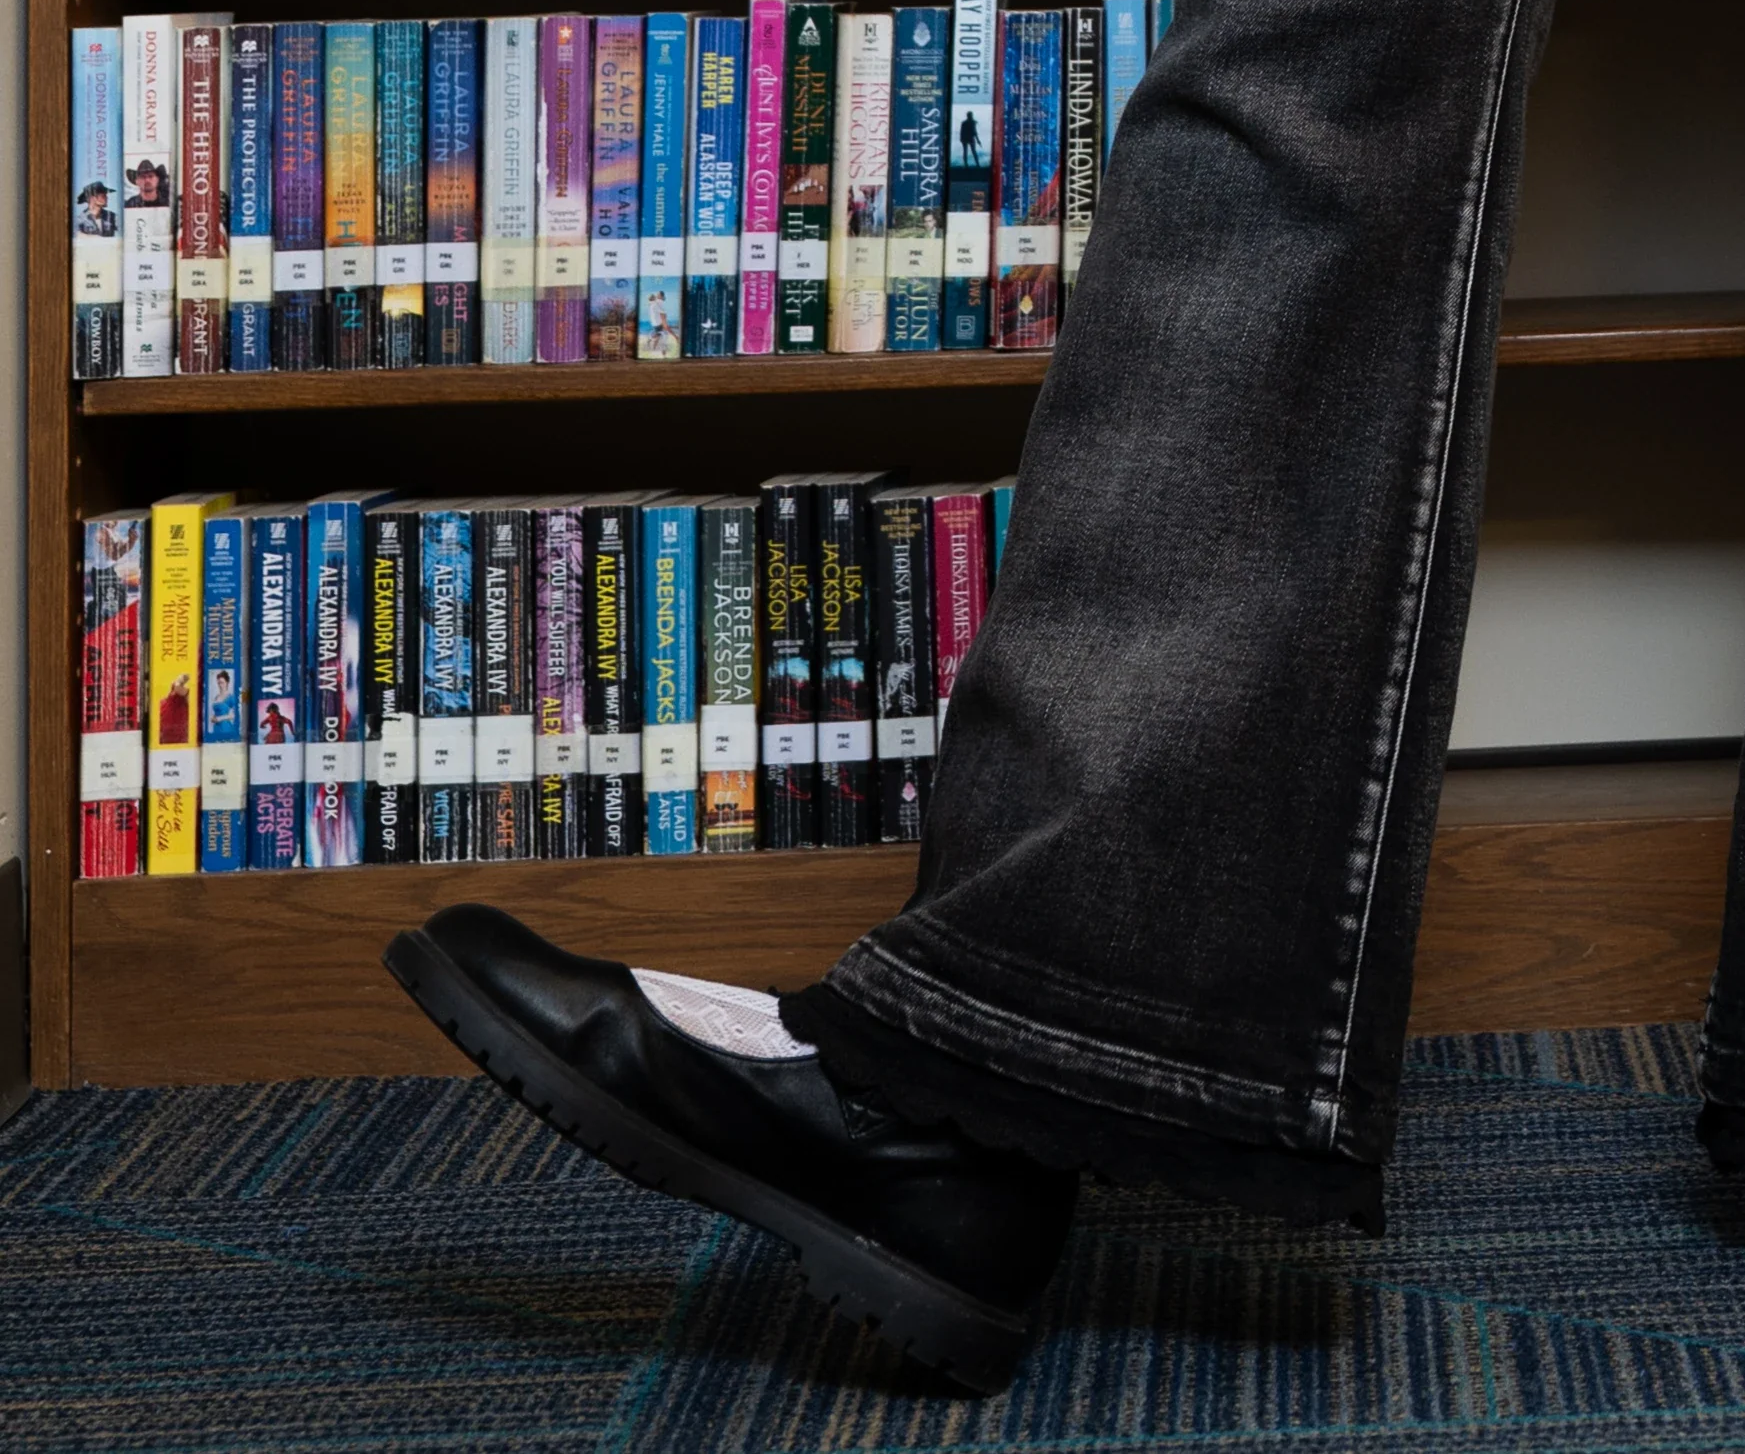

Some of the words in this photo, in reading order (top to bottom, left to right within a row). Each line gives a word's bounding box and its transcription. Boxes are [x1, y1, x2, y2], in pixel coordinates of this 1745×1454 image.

[144, 30, 158, 84] DONNA
[956, 21, 984, 96] HOOPER
[144, 88, 159, 142] GRANT
[192, 79, 210, 123] THE
[241, 74, 258, 112] THE
[651, 71, 670, 118] JENNY
[192, 131, 211, 196] HERO
[651, 122, 667, 158] HALE
[899, 128, 919, 184] HILL
[919, 107, 944, 203] SANDRA
[241, 117, 258, 228] PROTECTOR
[550, 557, 566, 587] YOU
[821, 538, 841, 632] JACKSON
[841, 564, 861, 604] LISA
[260, 551, 286, 661] ALEXANDRA
[550, 589, 566, 618] WILL
[548, 621, 565, 677] SUFFER
[261, 666, 285, 696] IVY
[256, 792, 275, 835] ACTS
[431, 790, 451, 838] VICTIM
